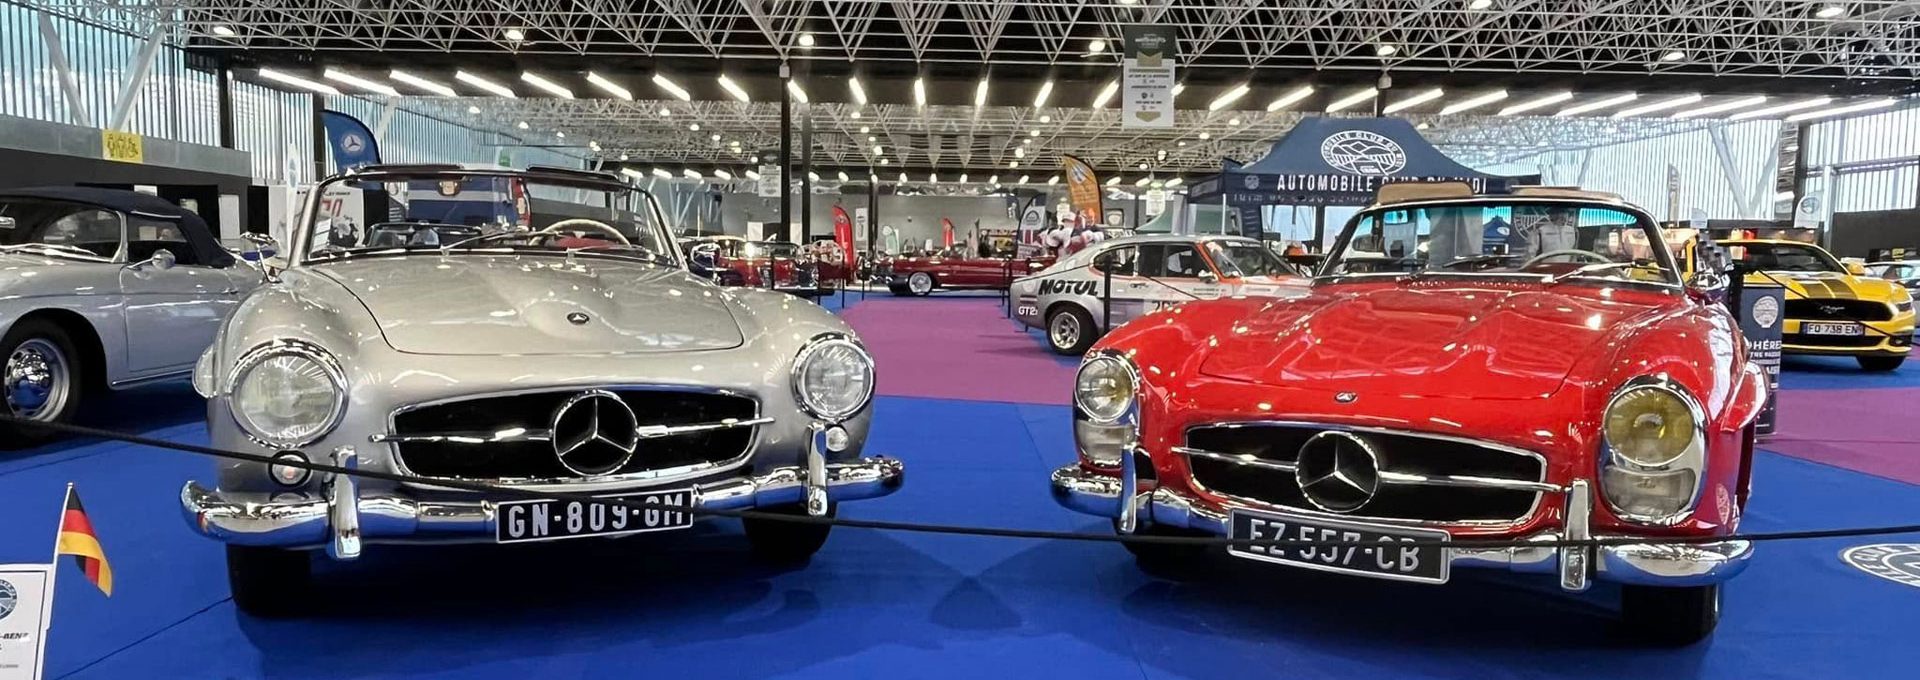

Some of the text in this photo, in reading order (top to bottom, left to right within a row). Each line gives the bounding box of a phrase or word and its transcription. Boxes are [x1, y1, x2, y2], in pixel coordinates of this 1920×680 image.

[1277, 174, 1374, 192] AUTOMOBILE
[1038, 279, 1098, 296] MOTUL
[508, 493, 684, 538] GN-809-GM
[1250, 518, 1420, 572] EZ-557-CB
